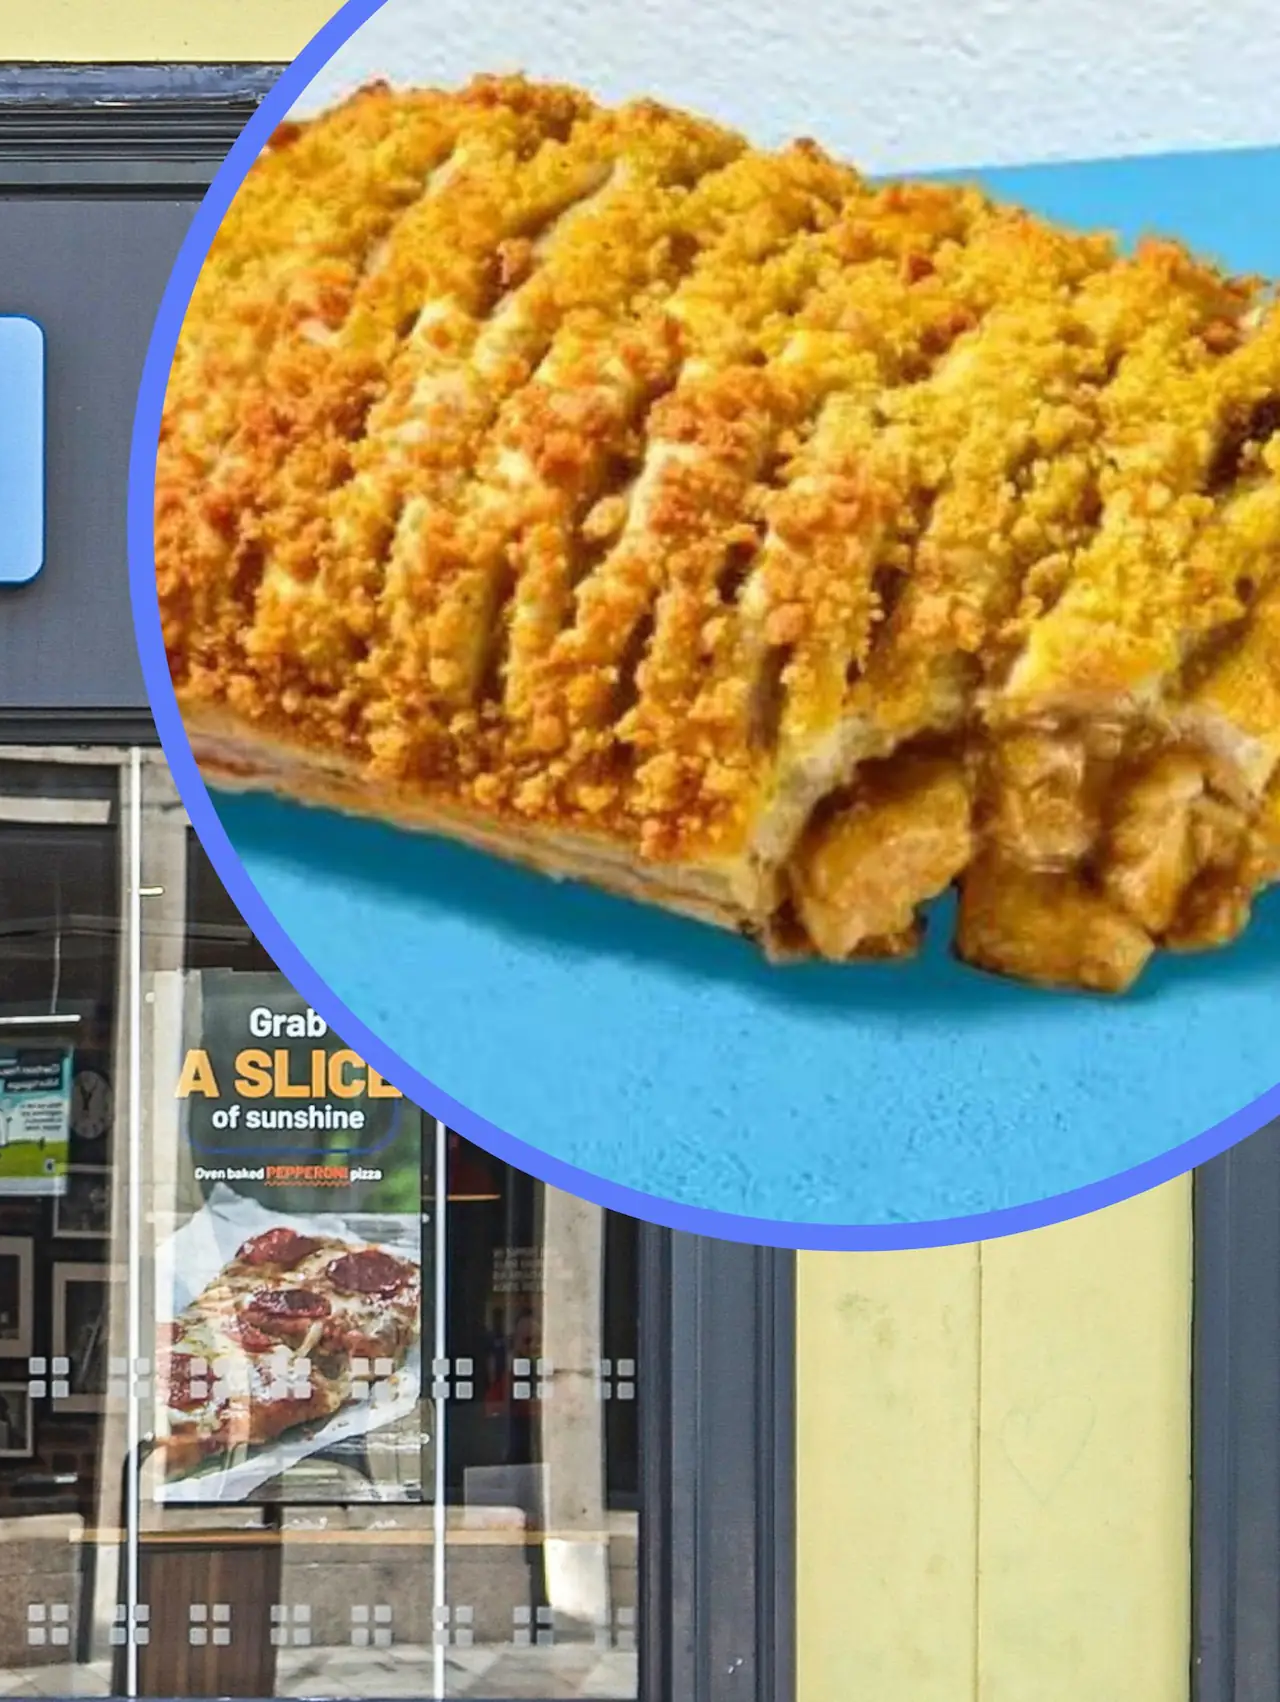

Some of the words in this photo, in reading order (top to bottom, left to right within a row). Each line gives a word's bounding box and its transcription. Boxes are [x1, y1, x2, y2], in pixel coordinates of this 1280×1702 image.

[249, 1007, 328, 1038] Grab
[174, 1048, 220, 1099] A
[212, 1105, 241, 1129] of
[245, 1105, 365, 1129] sunshine
[194, 1168, 226, 1181] Oven
[227, 1167, 264, 1181] baked
[266, 1166, 349, 1180] PEPPERONI
[350, 1167, 383, 1182] pizza
